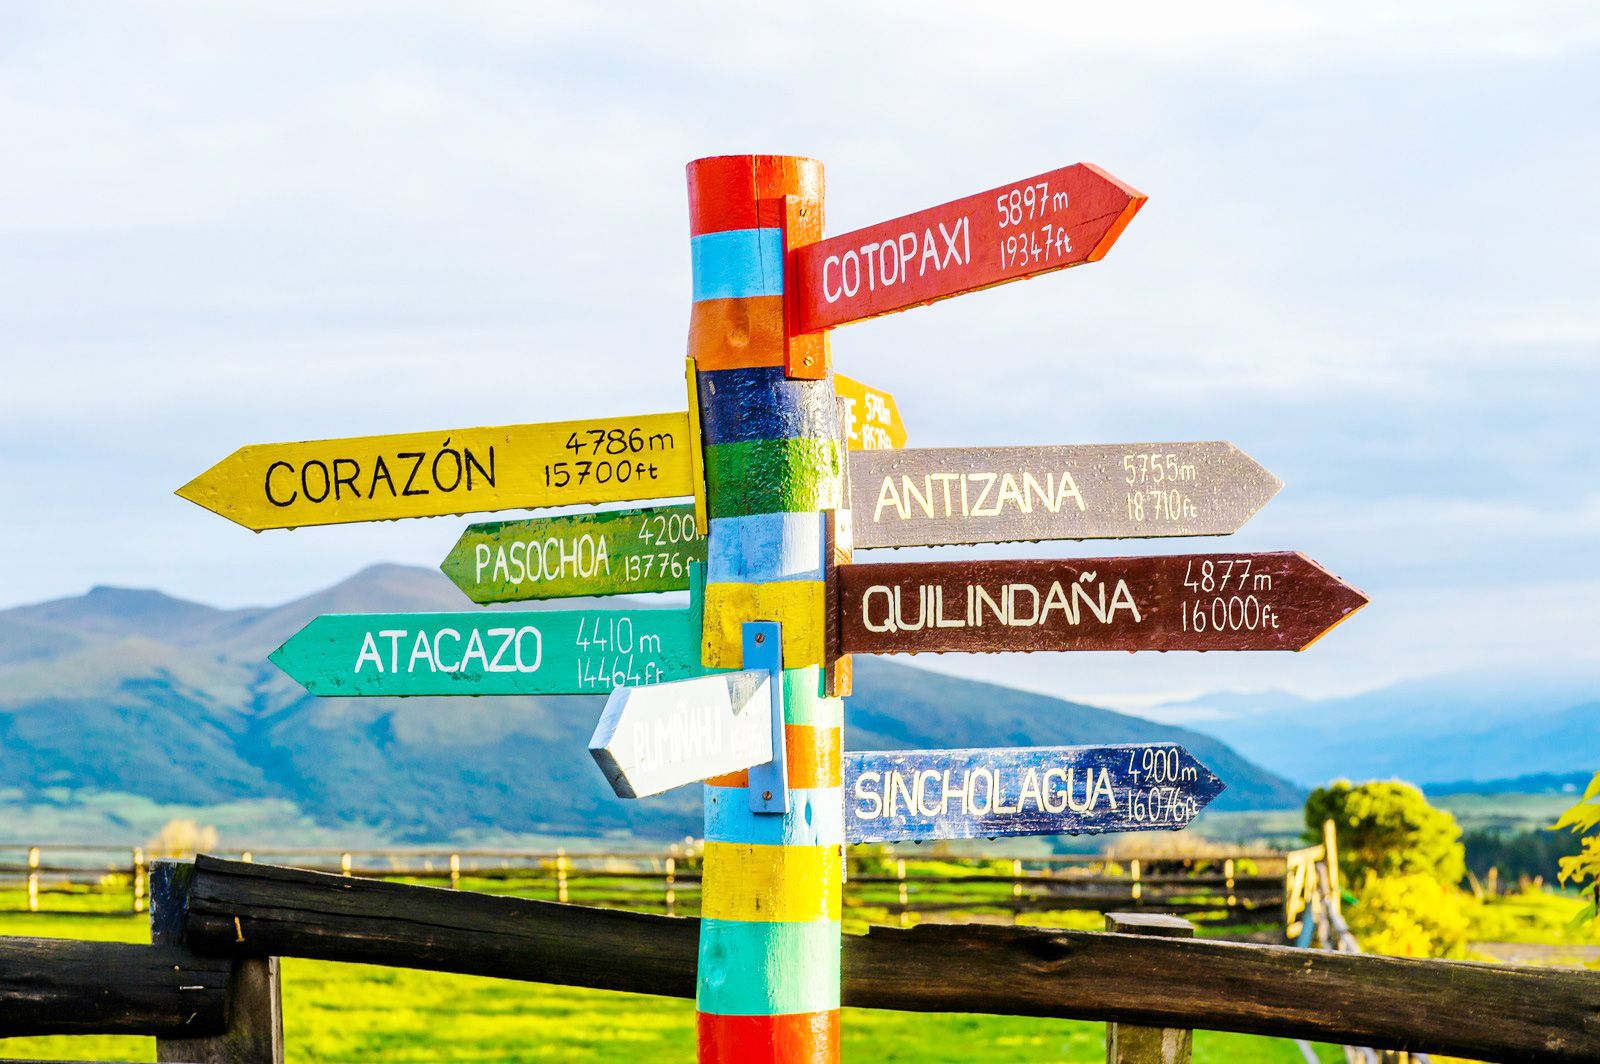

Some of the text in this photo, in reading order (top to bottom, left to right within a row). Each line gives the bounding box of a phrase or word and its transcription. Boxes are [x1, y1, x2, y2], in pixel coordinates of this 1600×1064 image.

[997, 182, 1068, 229] 5897m
[822, 216, 970, 303] COTOPAXI
[1000, 224, 1072, 269] 19347ft
[565, 428, 674, 453] 4786m
[265, 437, 496, 507] CORAZÓN
[545, 460, 658, 488] 15700ft
[1124, 454, 1196, 484] 5755m
[874, 472, 1085, 521] ANTIZANA
[638, 514, 704, 546] 4200
[476, 534, 610, 584] PASOCHOA
[625, 553, 699, 581] 13776f
[1183, 560, 1272, 593] 4877m
[862, 571, 1141, 633] QUILINDAÑA
[354, 626, 542, 673] ATACAZO
[855, 766, 1117, 820] SINCHOLAGUA
